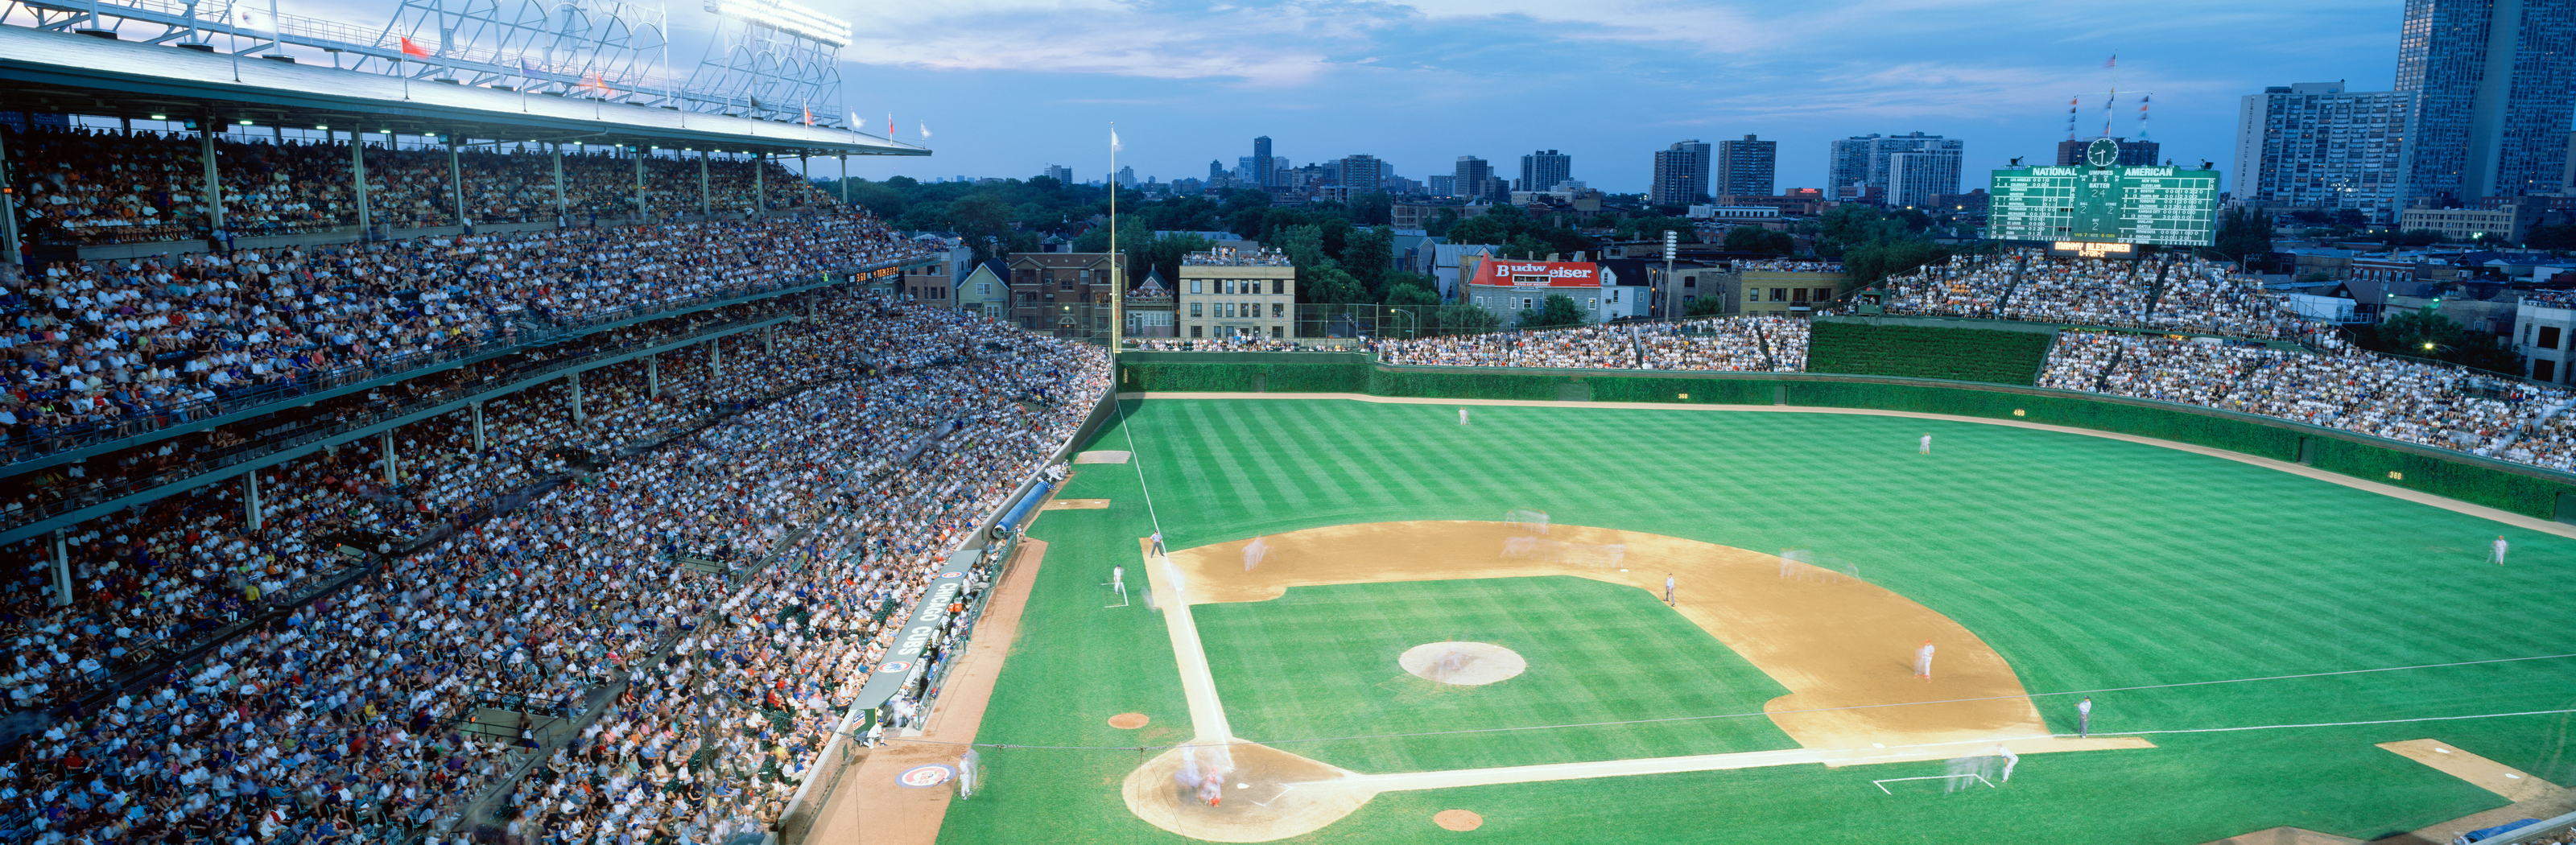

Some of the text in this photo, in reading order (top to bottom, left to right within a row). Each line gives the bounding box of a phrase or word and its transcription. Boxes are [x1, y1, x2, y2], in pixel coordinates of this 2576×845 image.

[2124, 168, 2173, 176] AMERICAN
[2091, 189, 2105, 197] 24
[2080, 206, 2114, 214] 2 2
[2092, 222, 2099, 230] 2
[2054, 241, 2131, 253] MANNY ALEXANDER
[857, 274, 860, 282] 3
[2390, 472, 2401, 480] 368
[919, 583, 958, 621] CHICAGO
[898, 626, 932, 655] CUBS
[853, 718, 865, 730] SPORTS
